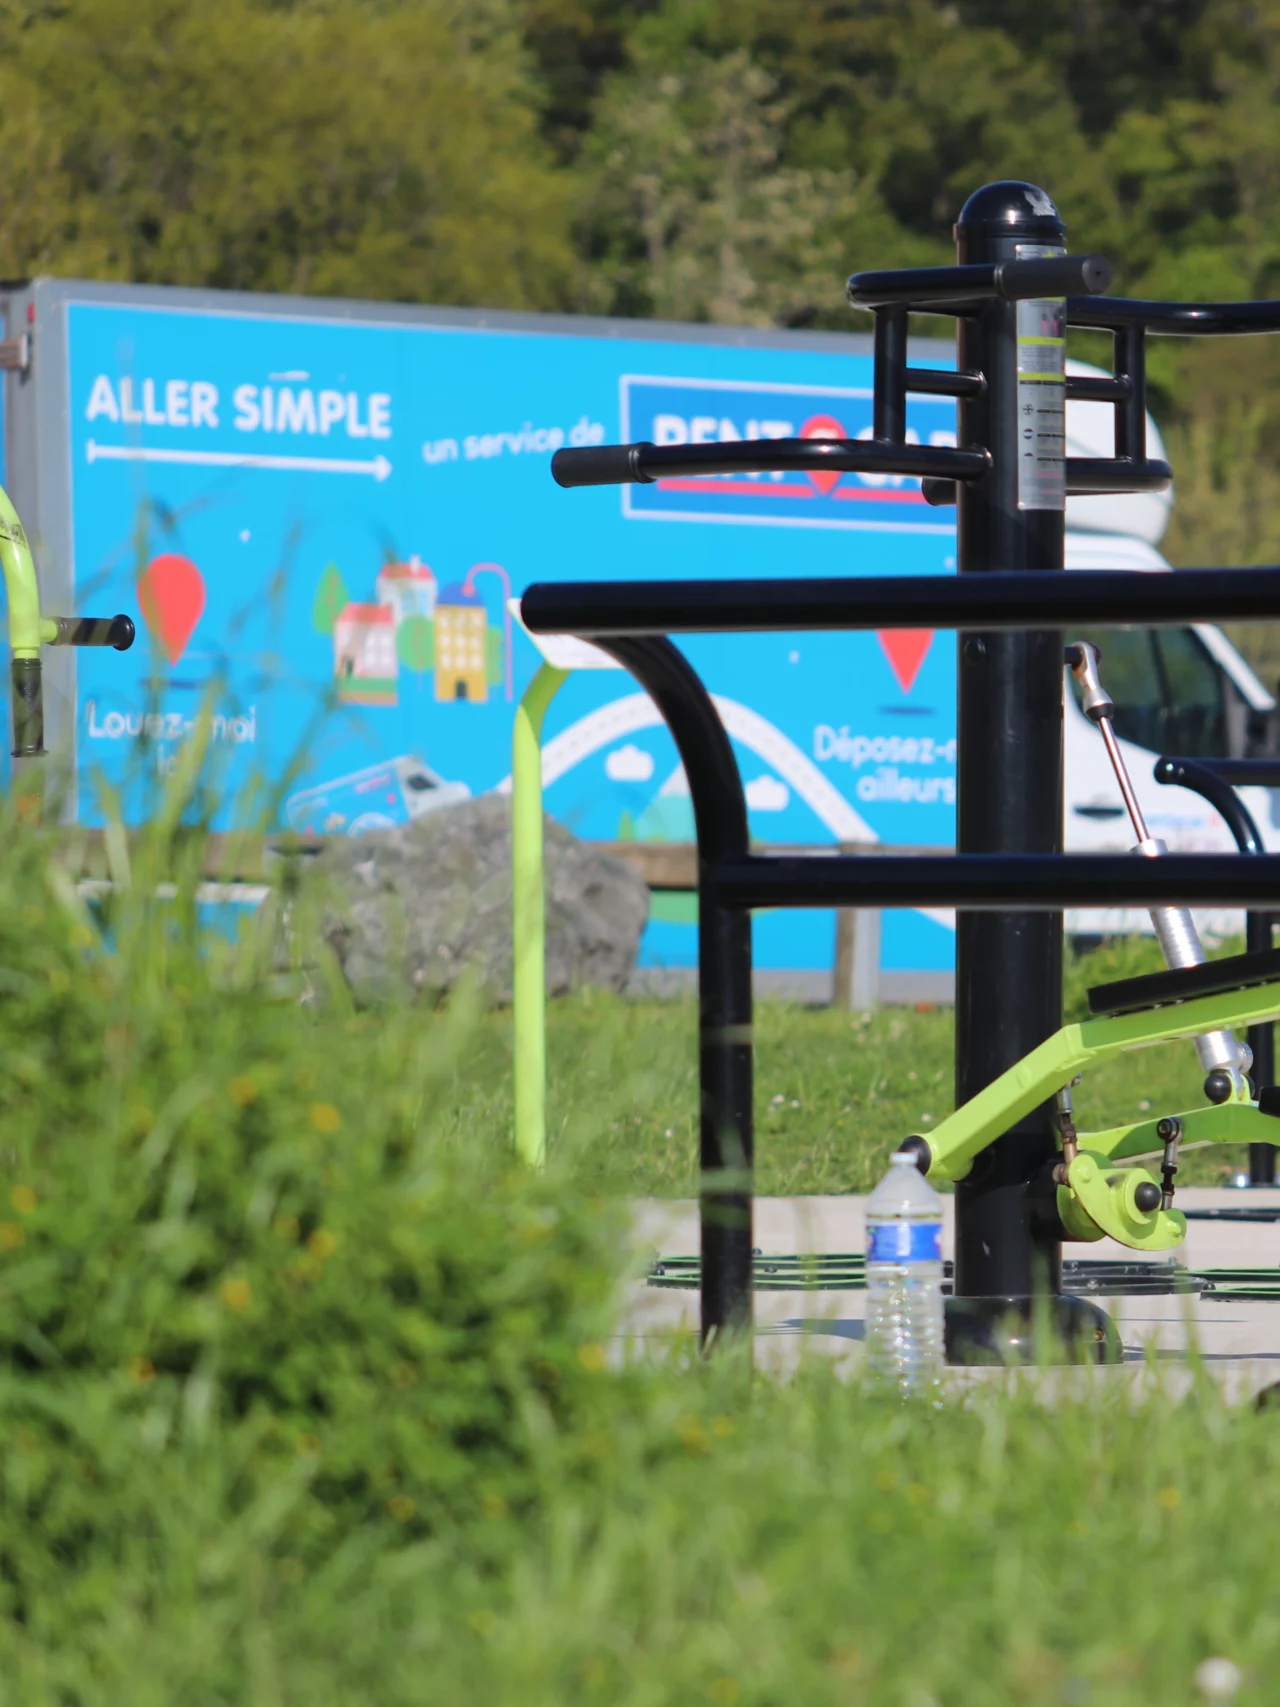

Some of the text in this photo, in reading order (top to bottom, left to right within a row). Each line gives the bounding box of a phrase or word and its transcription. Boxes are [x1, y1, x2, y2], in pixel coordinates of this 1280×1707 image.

[86, 374, 392, 439] ALLER SIMPLE
[423, 415, 605, 465] un service de
